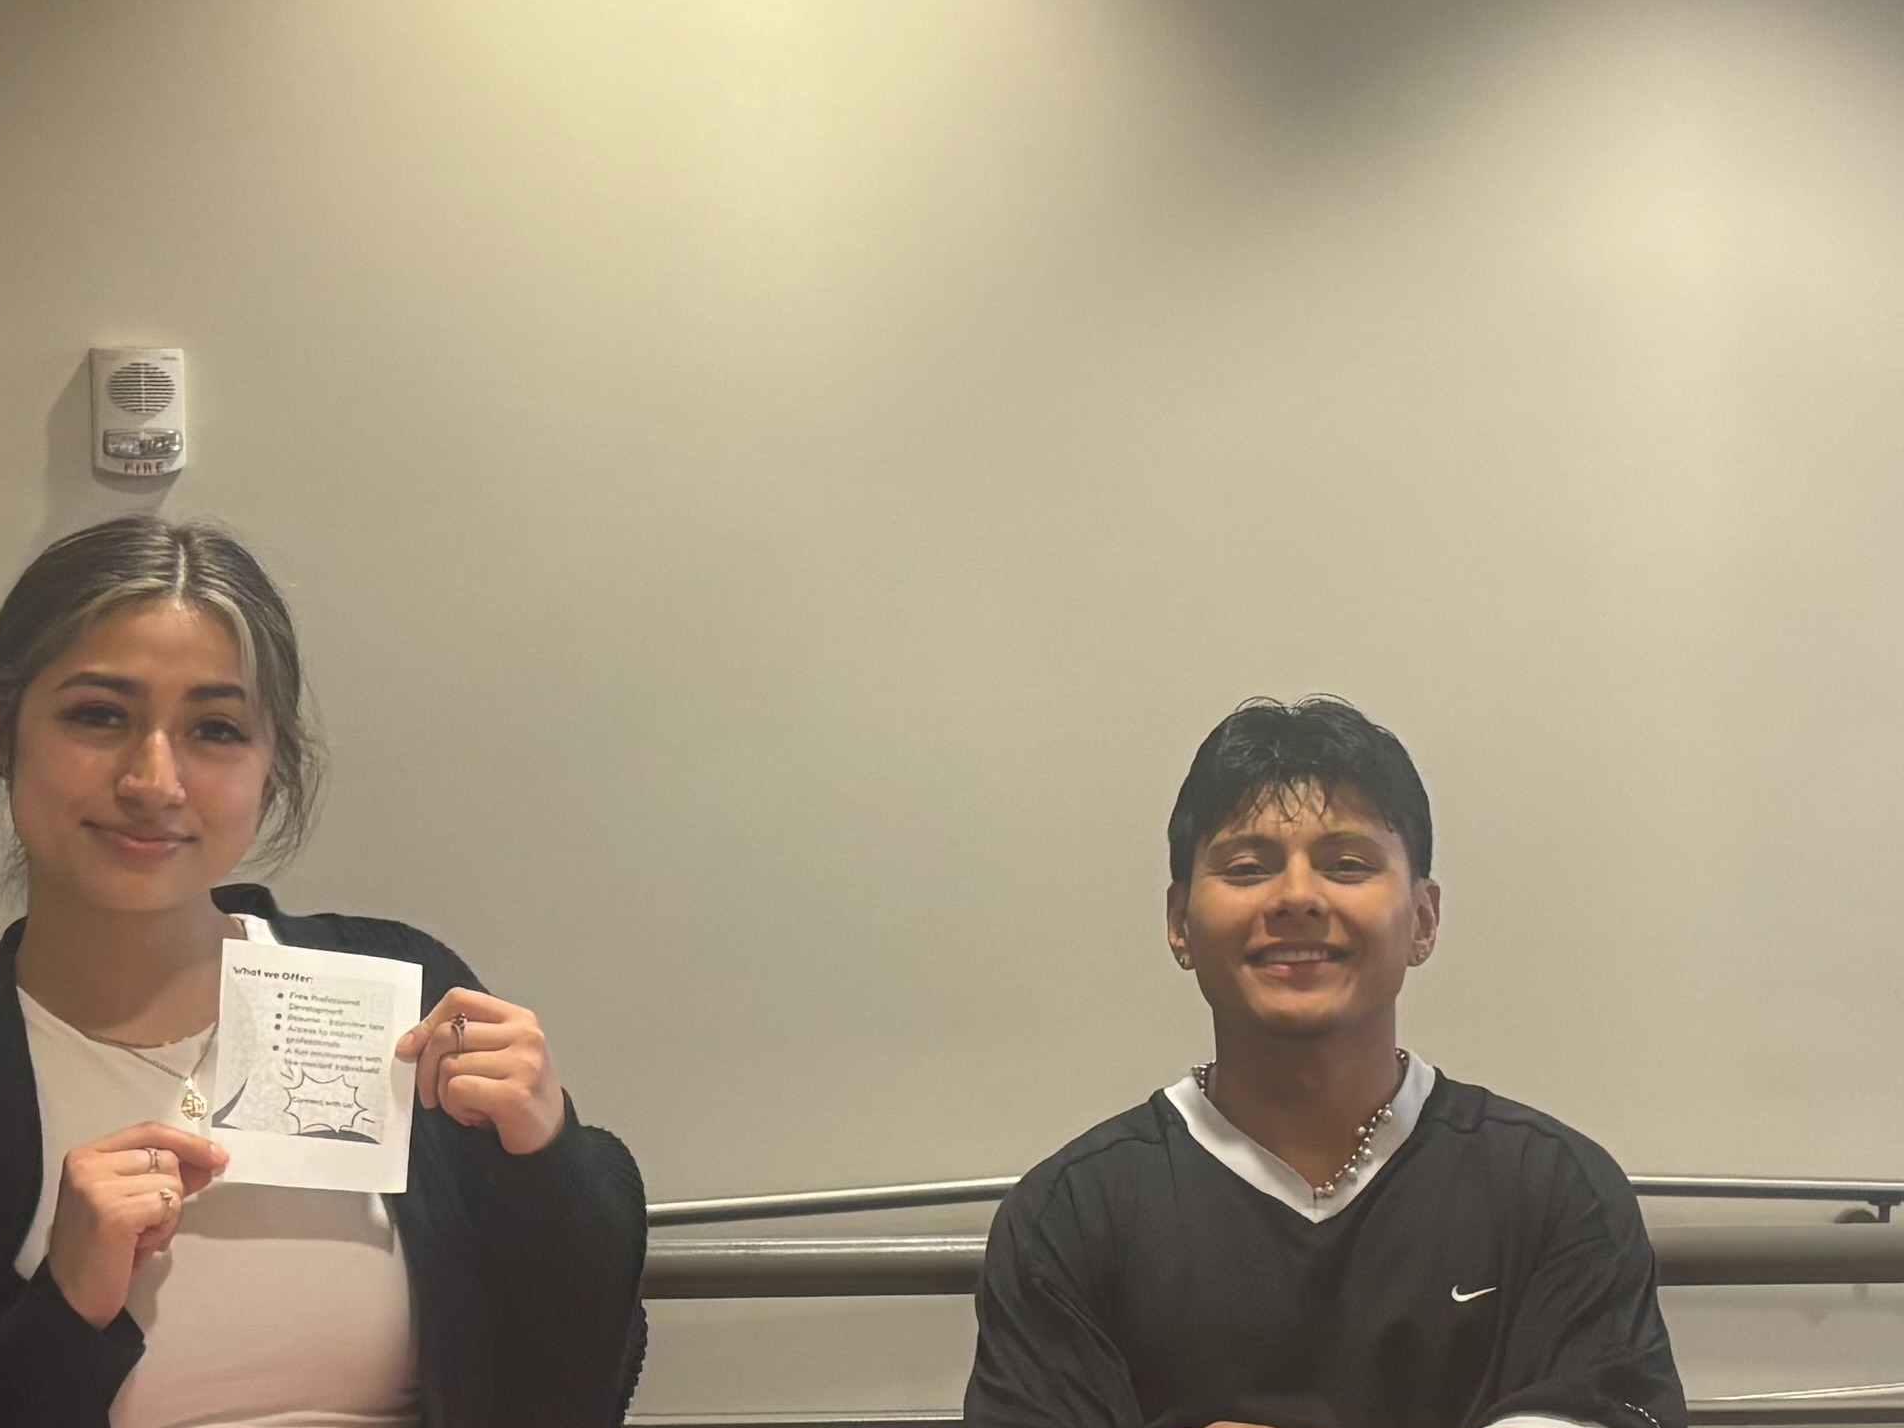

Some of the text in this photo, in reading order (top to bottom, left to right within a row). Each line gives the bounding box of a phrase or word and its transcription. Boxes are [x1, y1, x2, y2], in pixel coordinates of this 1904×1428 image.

[124, 462, 166, 475] FIRE
[233, 966, 314, 984] What we Offer:
